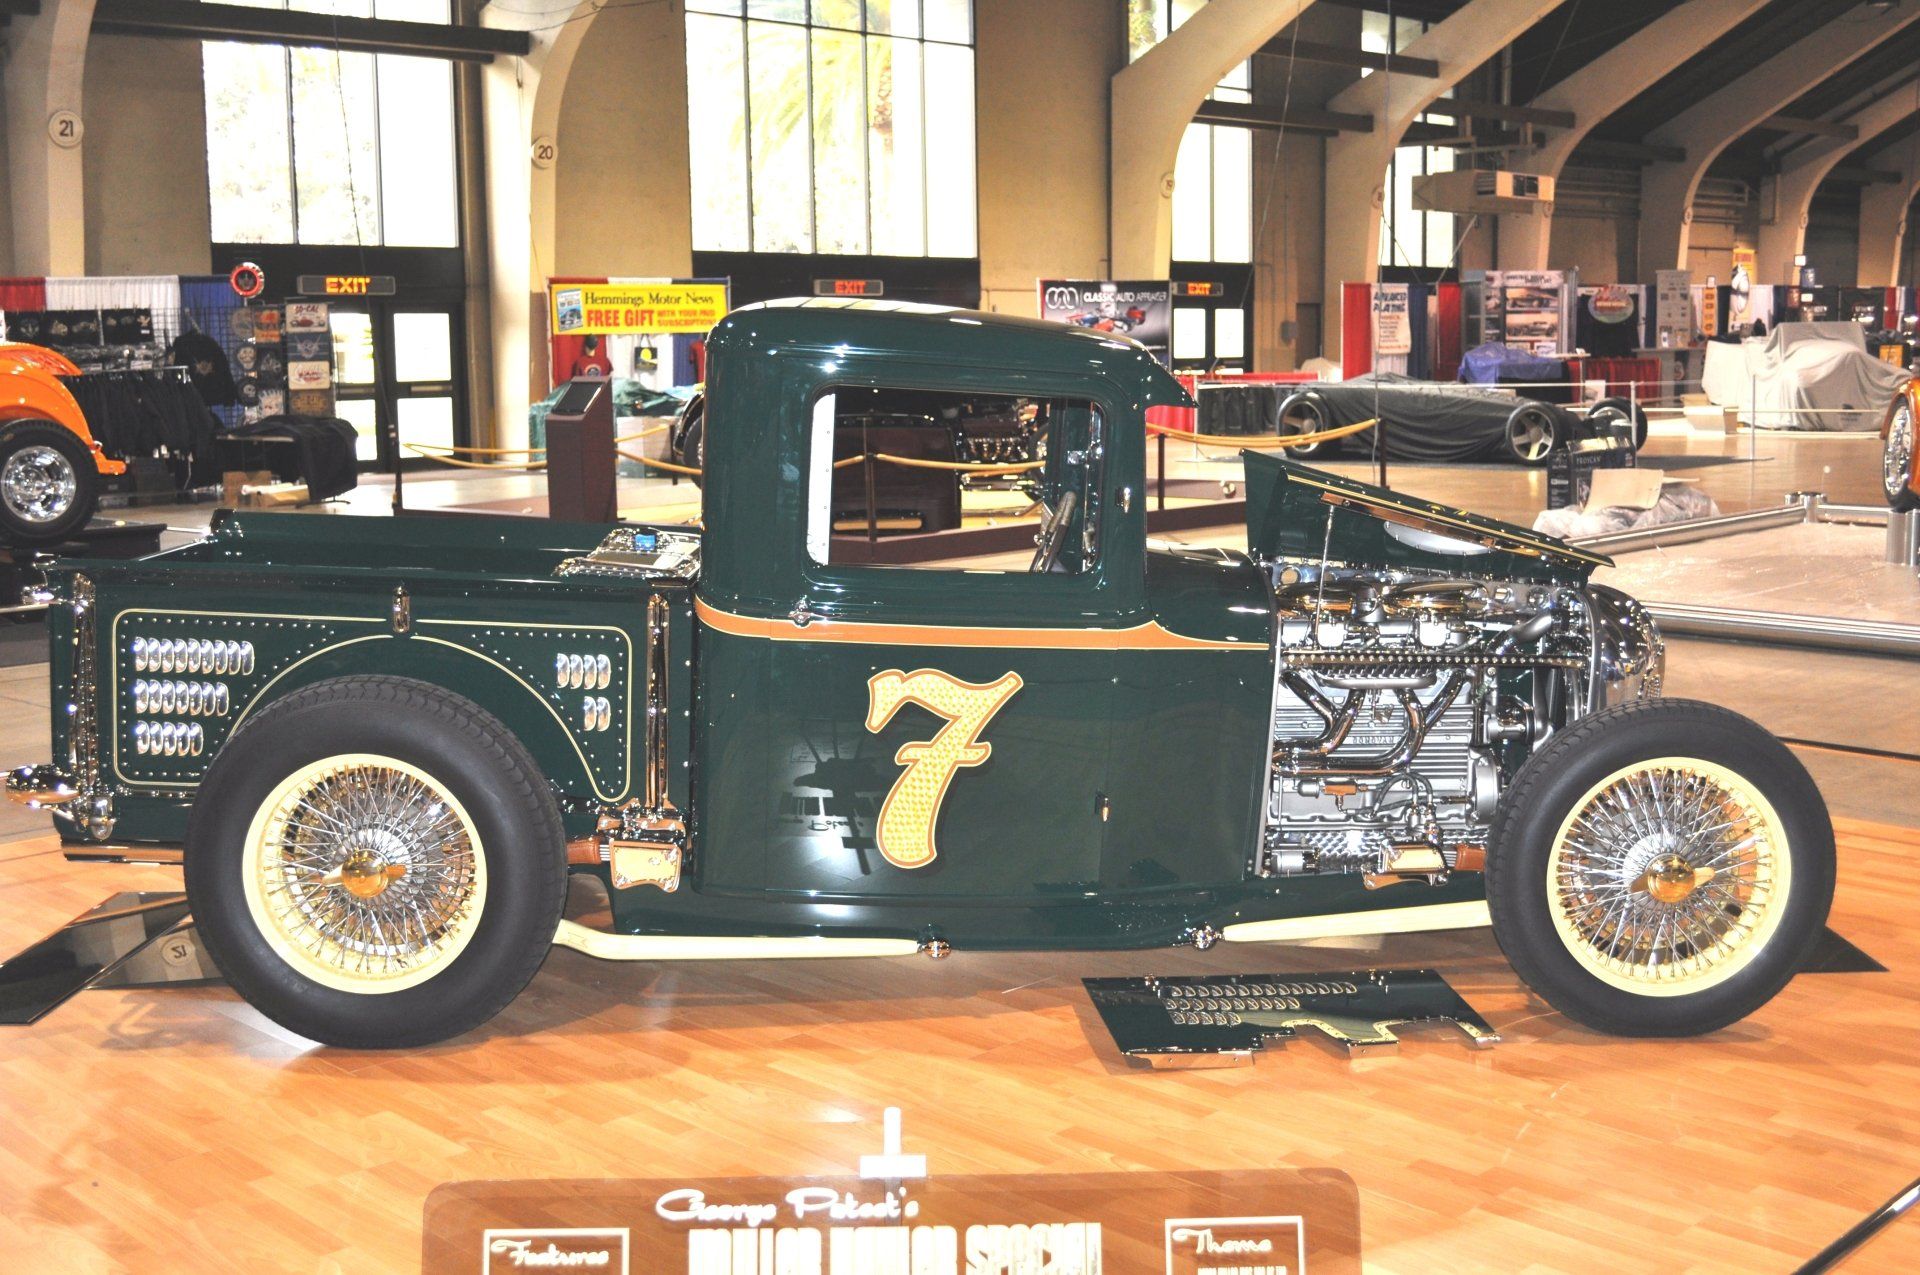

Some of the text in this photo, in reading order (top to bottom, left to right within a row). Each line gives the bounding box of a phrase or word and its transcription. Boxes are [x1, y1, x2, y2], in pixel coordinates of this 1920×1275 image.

[59, 119, 74, 137] 21
[538, 145, 554, 160] 20
[325, 276, 371, 294] EXIT
[835, 280, 866, 295] EXIT
[1187, 282, 1211, 296] EXIT
[585, 292, 645, 307] Hemmings
[649, 292, 682, 305] Motor
[686, 291, 714, 305] News
[1083, 291, 1116, 303] CLASSIC
[1116, 291, 1135, 302] AUTO
[586, 309, 655, 327] FREE GIFT
[865, 668, 1024, 869] 7
[655, 1187, 777, 1228] George
